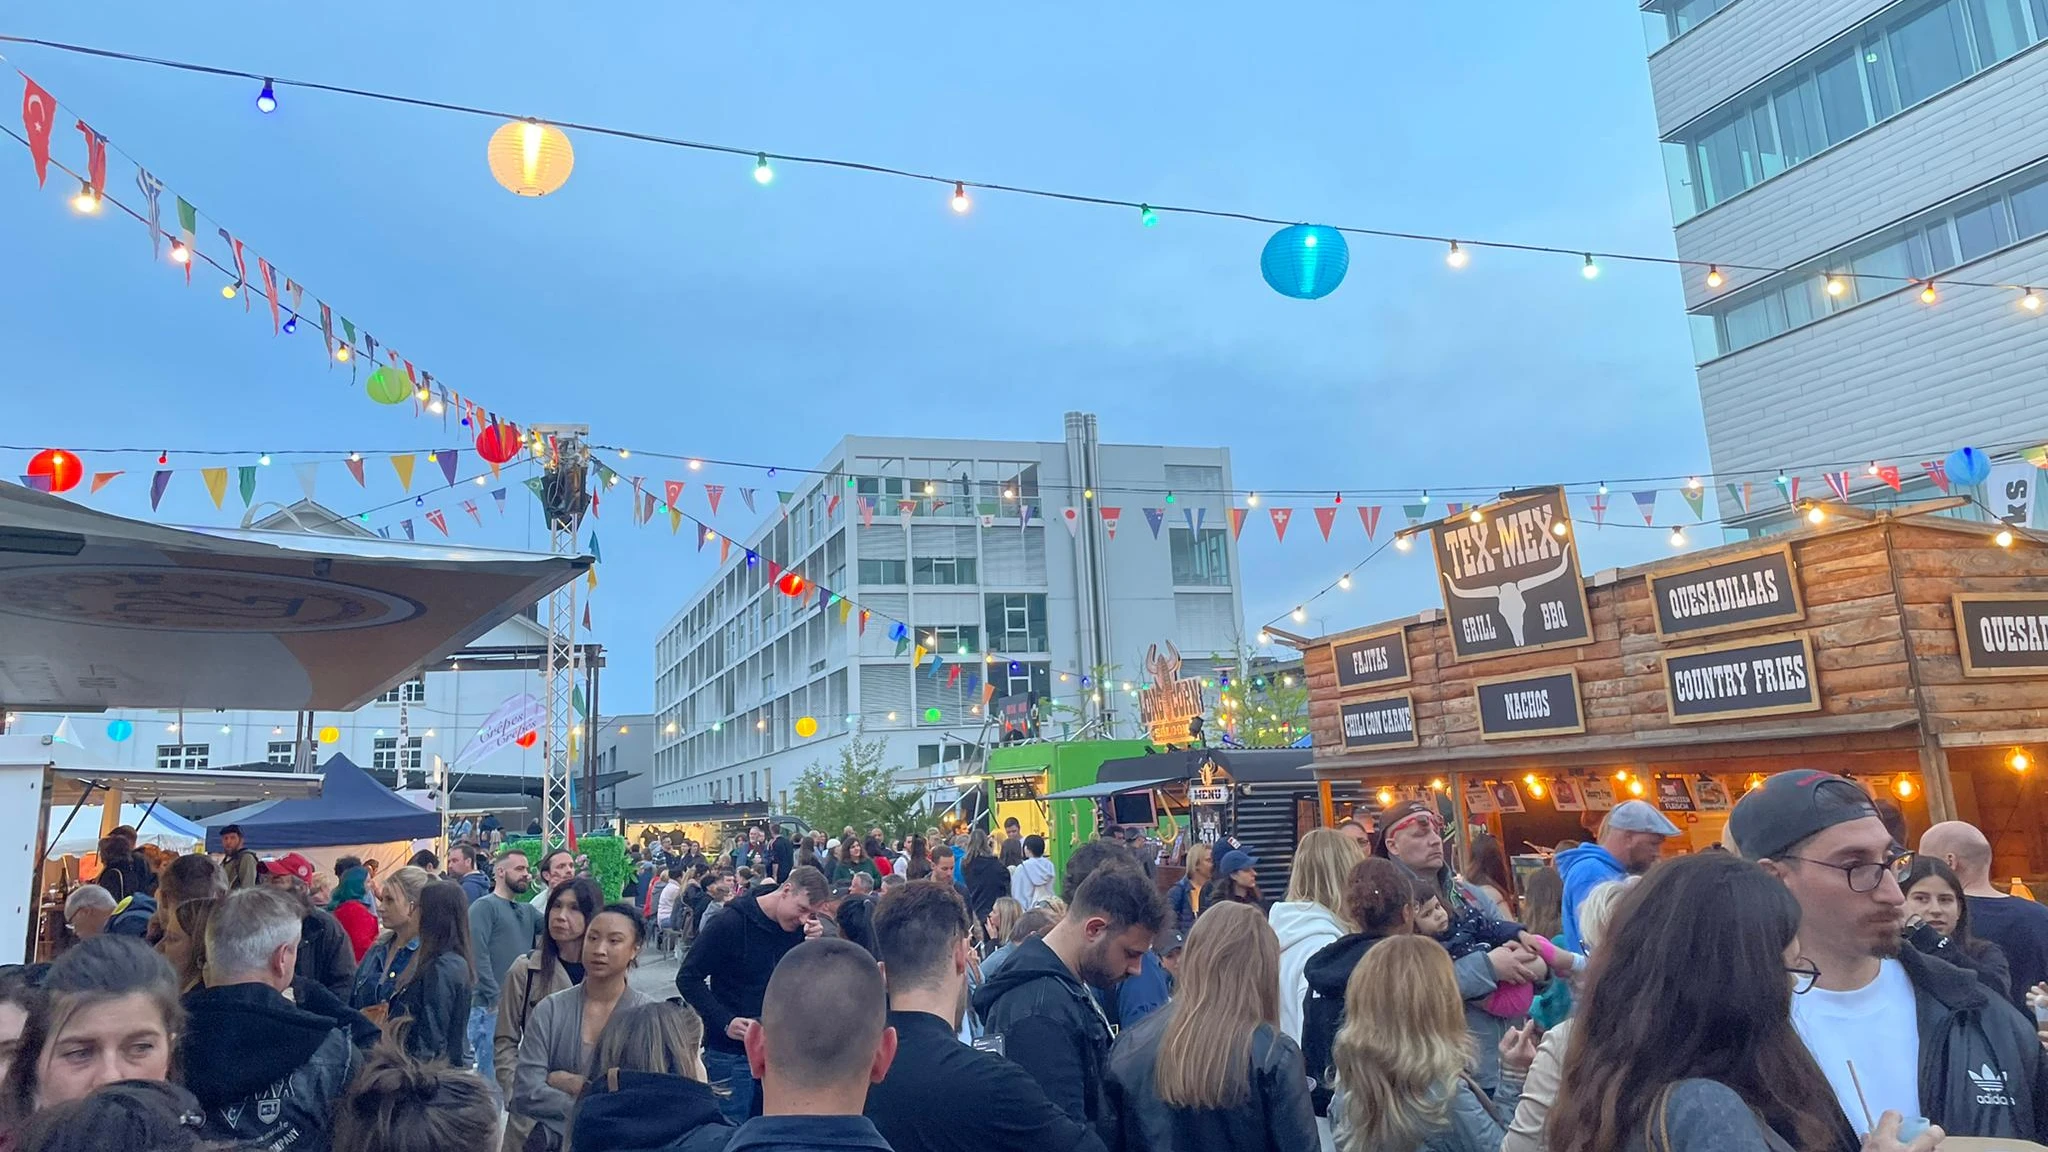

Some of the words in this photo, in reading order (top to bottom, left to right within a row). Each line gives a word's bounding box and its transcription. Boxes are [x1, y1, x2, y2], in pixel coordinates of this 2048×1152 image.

[1444, 504, 1560, 579] TEX-MEX
[1669, 569, 1779, 619] QUESADILLAS
[1462, 613, 1497, 643] GRILL
[1540, 600, 1569, 631] BBQ
[1352, 646, 1388, 675] FAJITAS
[1675, 662, 1747, 702] COUNTRY
[1752, 655, 1807, 694] FRIES
[1504, 689, 1551, 721] NACHOS
[1344, 713, 1366, 738] CHILI
[1365, 710, 1382, 736] CON
[1381, 706, 1412, 733] CARNE
[1194, 789, 1221, 801] MENU
